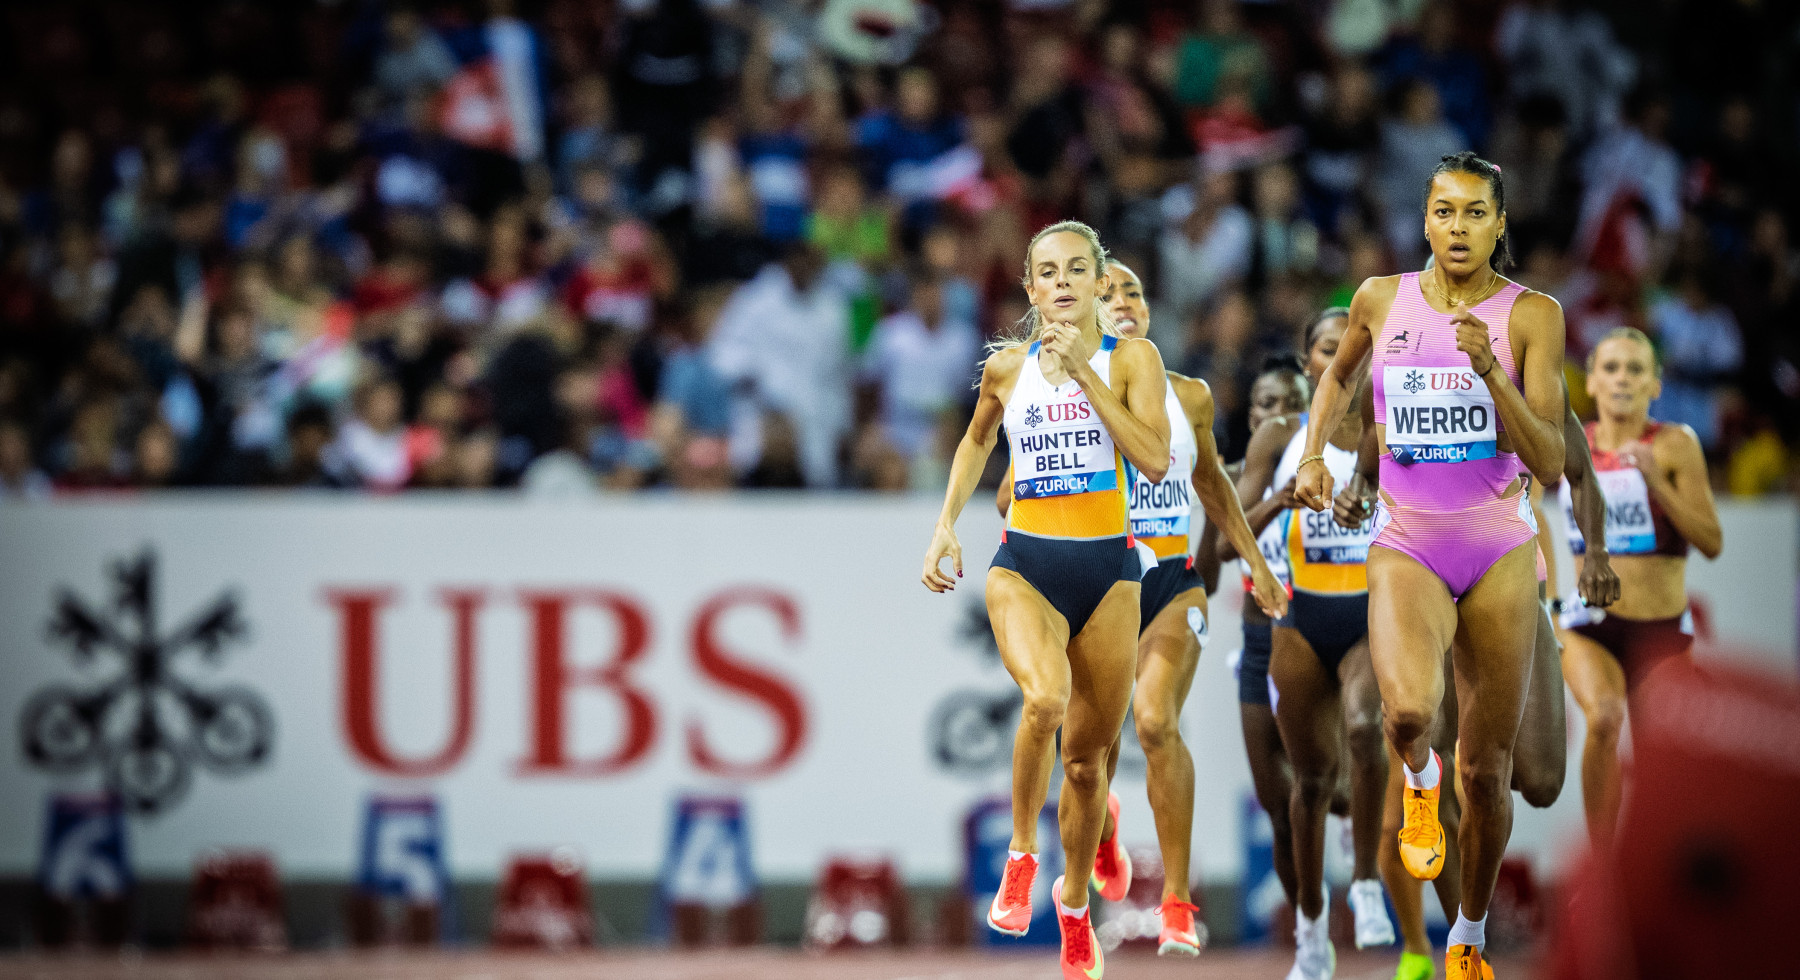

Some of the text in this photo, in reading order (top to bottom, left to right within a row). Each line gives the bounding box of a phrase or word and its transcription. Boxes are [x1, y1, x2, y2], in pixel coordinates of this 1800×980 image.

[1430, 372, 1473, 390] UBS
[1046, 401, 1091, 422] UBS
[1393, 405, 1488, 434] WERRO
[1020, 429, 1102, 453] HUNTER
[1036, 452, 1086, 472] BELL
[1412, 446, 1467, 460] ZURICH
[1035, 476, 1088, 494] ZURICH
[1131, 520, 1173, 534] URICH
[324, 586, 811, 778] UBS
[375, 815, 439, 905] 5
[668, 815, 741, 907] 4
